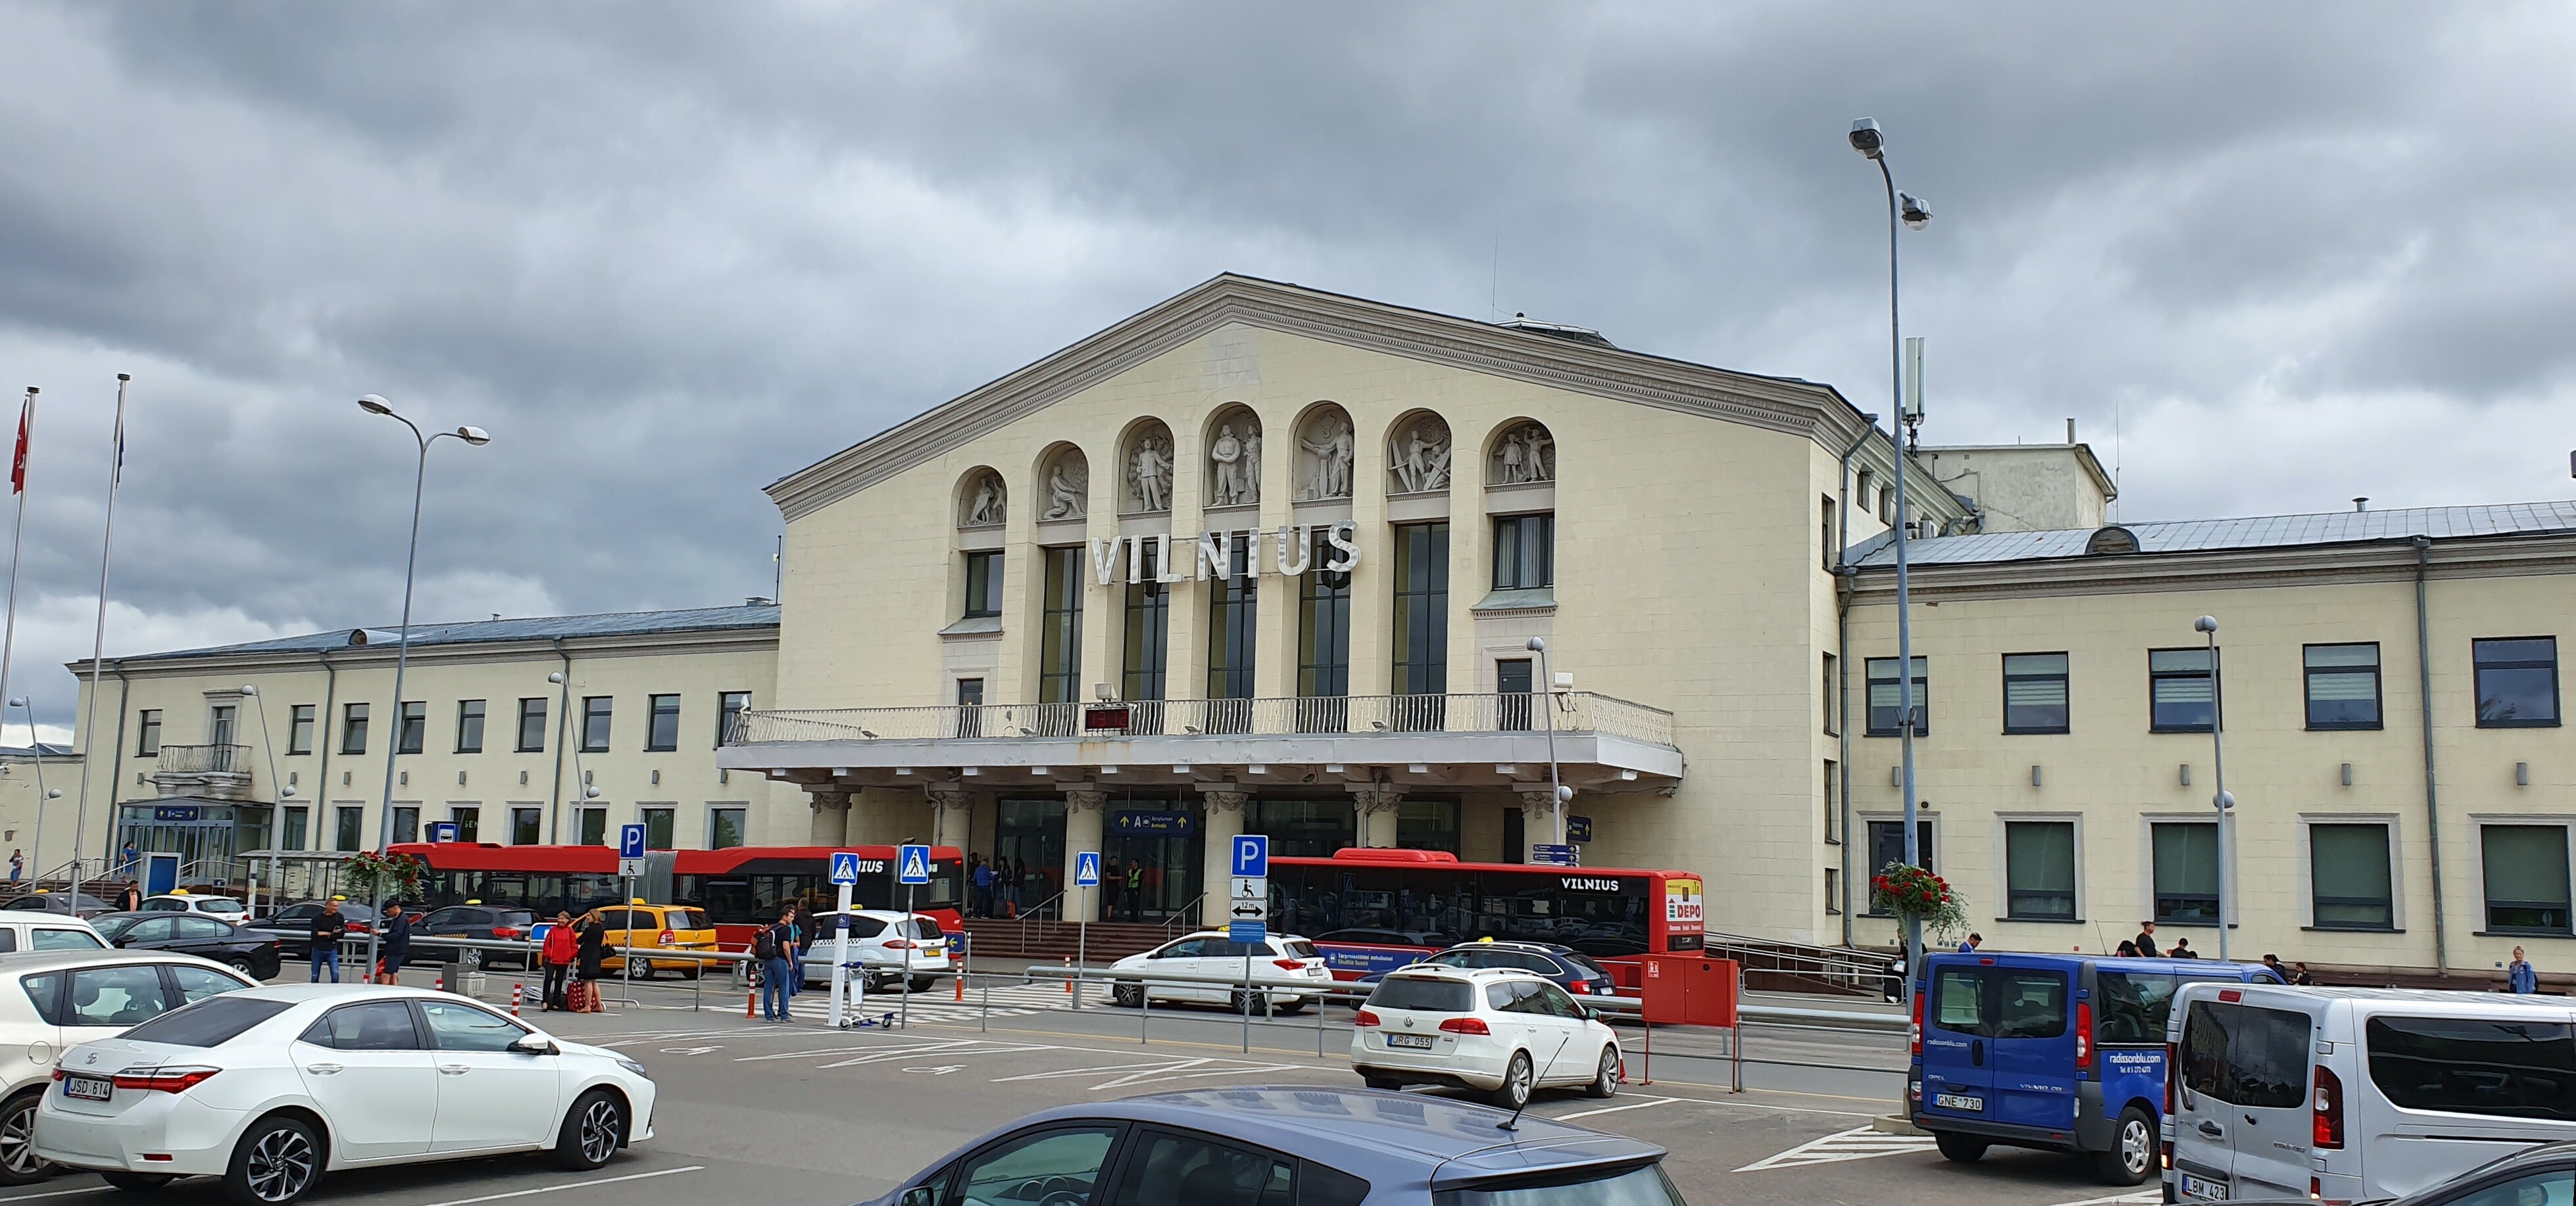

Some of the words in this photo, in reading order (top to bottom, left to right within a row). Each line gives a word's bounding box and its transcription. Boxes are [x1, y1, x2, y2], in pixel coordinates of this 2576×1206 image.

[1091, 519, 1362, 585] VILNIUS
[1134, 815, 1141, 827] A
[626, 827, 640, 854] P
[1241, 841, 1258, 871] P
[1561, 877, 1619, 892] VILNIUS
[1677, 904, 1700, 918] DEPO
[1415, 1038, 1430, 1046] 055
[2109, 1052, 2161, 1063] radissonblu.com
[70, 1080, 87, 1093] JSD
[92, 1082, 109, 1096] 614
[1938, 1096, 1958, 1106] GNE
[1964, 1098, 1981, 1109] 730
[2187, 1178, 2204, 1195] LBM
[2209, 1184, 2225, 1201] 423
